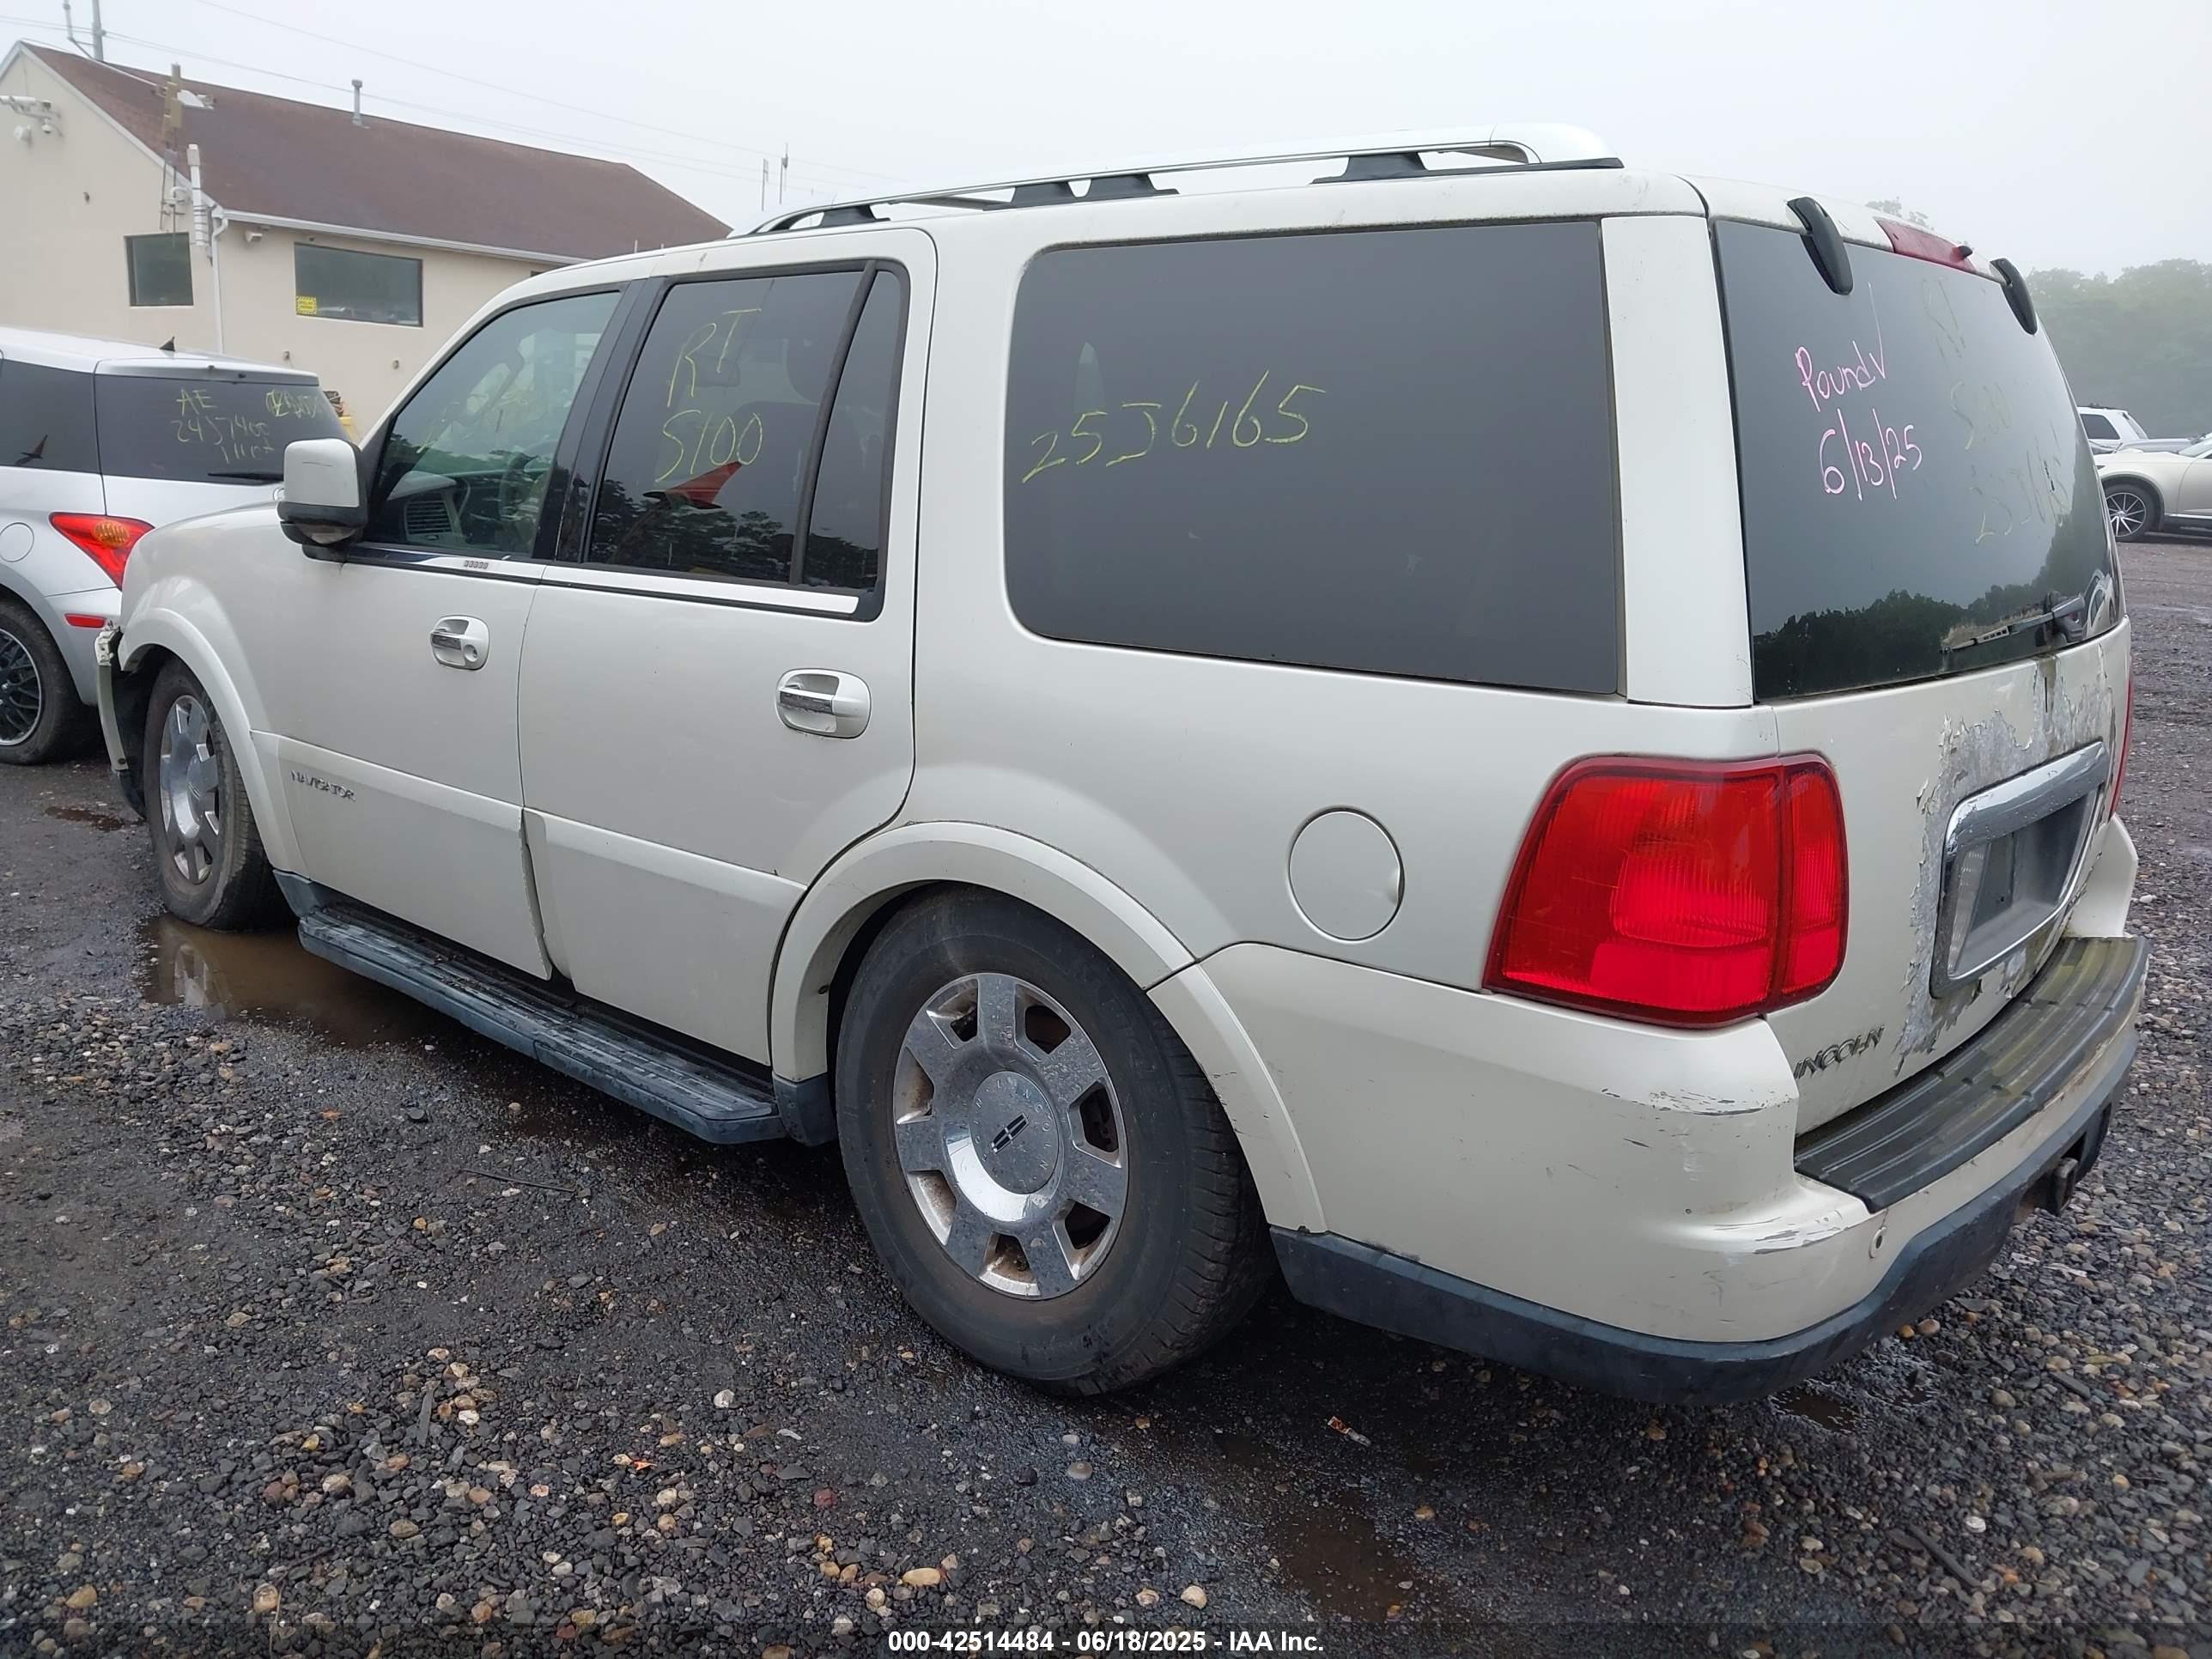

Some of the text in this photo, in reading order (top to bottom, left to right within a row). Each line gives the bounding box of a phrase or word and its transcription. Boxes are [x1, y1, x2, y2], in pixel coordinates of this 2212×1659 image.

[667, 308, 762, 408] RT
[176, 388, 216, 416] AE
[1819, 408, 1923, 501] 6/13/25
[290, 769, 356, 802] NAVIGATOR
[1793, 1024, 1886, 1079] INCOLN
